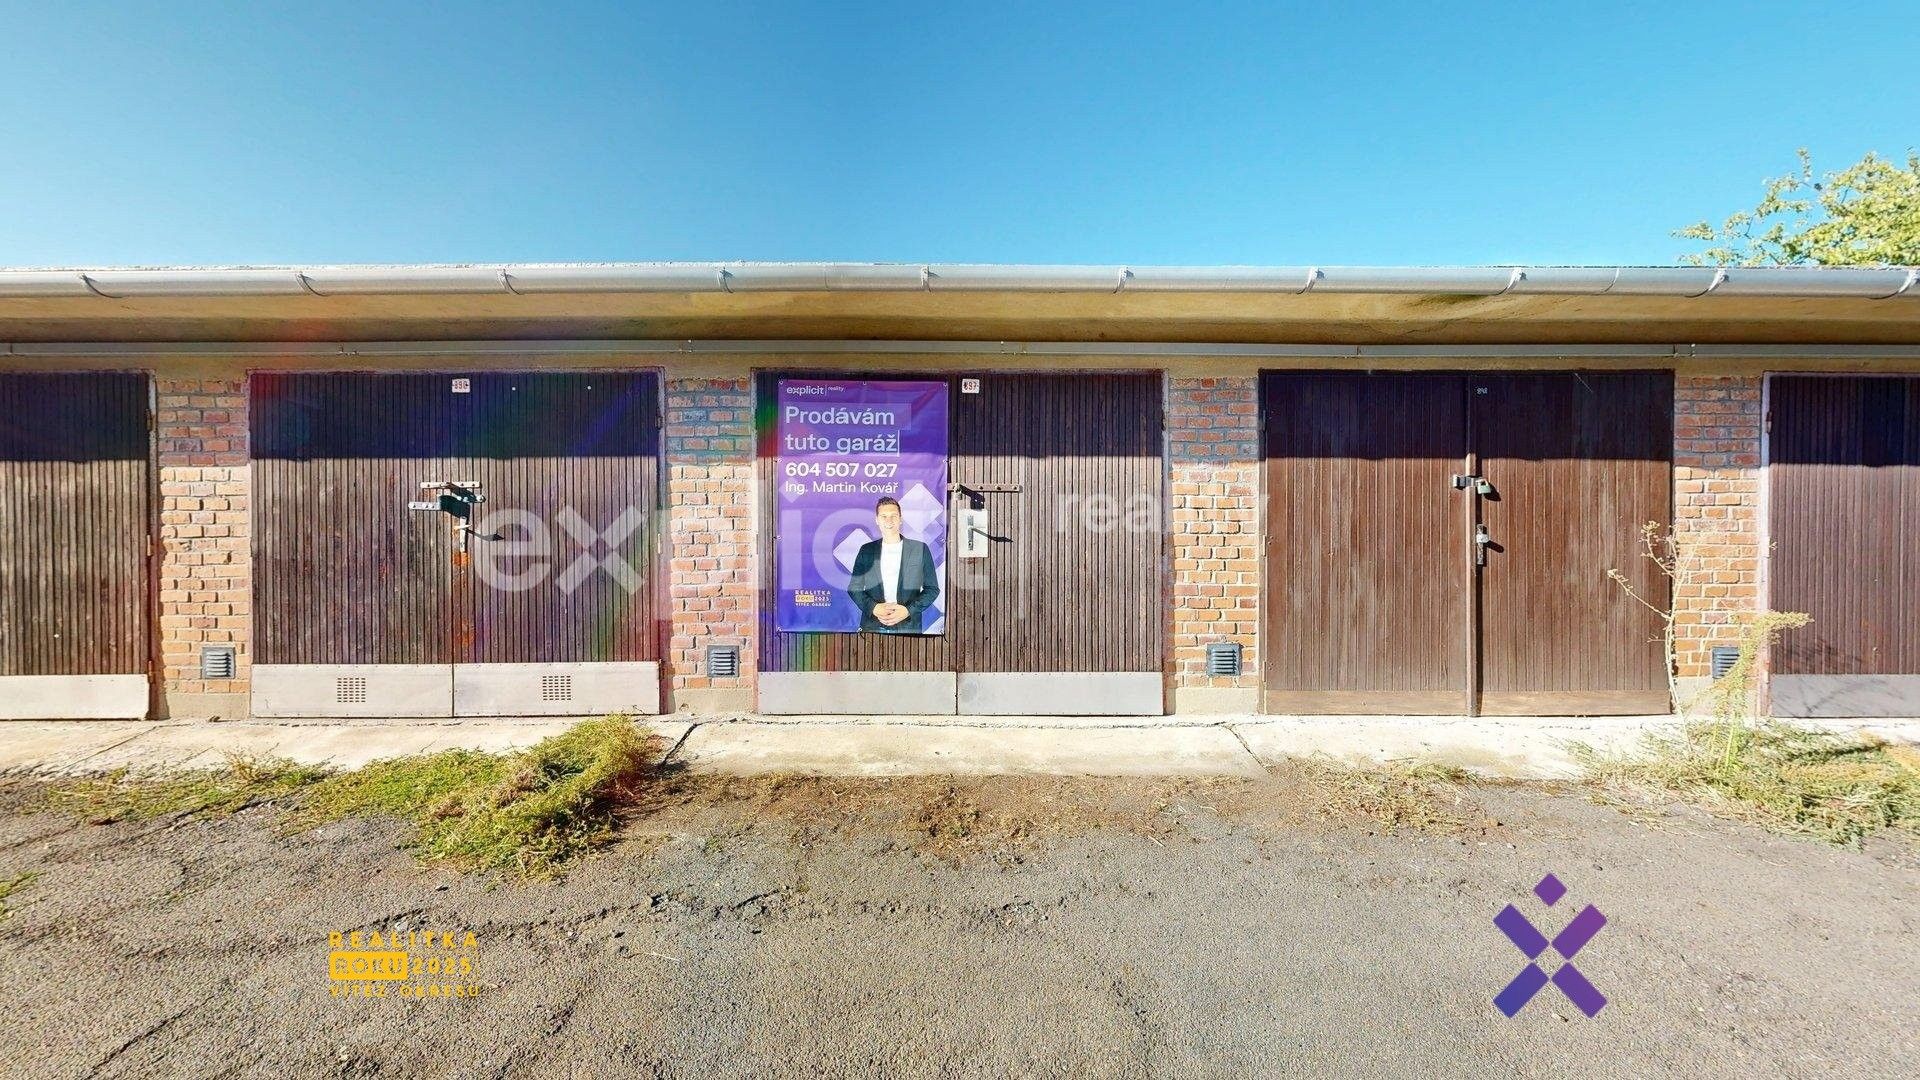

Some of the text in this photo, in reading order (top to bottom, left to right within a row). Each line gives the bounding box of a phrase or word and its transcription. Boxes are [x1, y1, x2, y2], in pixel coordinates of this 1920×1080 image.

[786, 385, 824, 396] explicit
[785, 406, 895, 425] Prodávám
[785, 433, 898, 455] tuto garáž
[785, 462, 898, 478] 604 507 027
[785, 481, 899, 495] Ing. Martin Kovář
